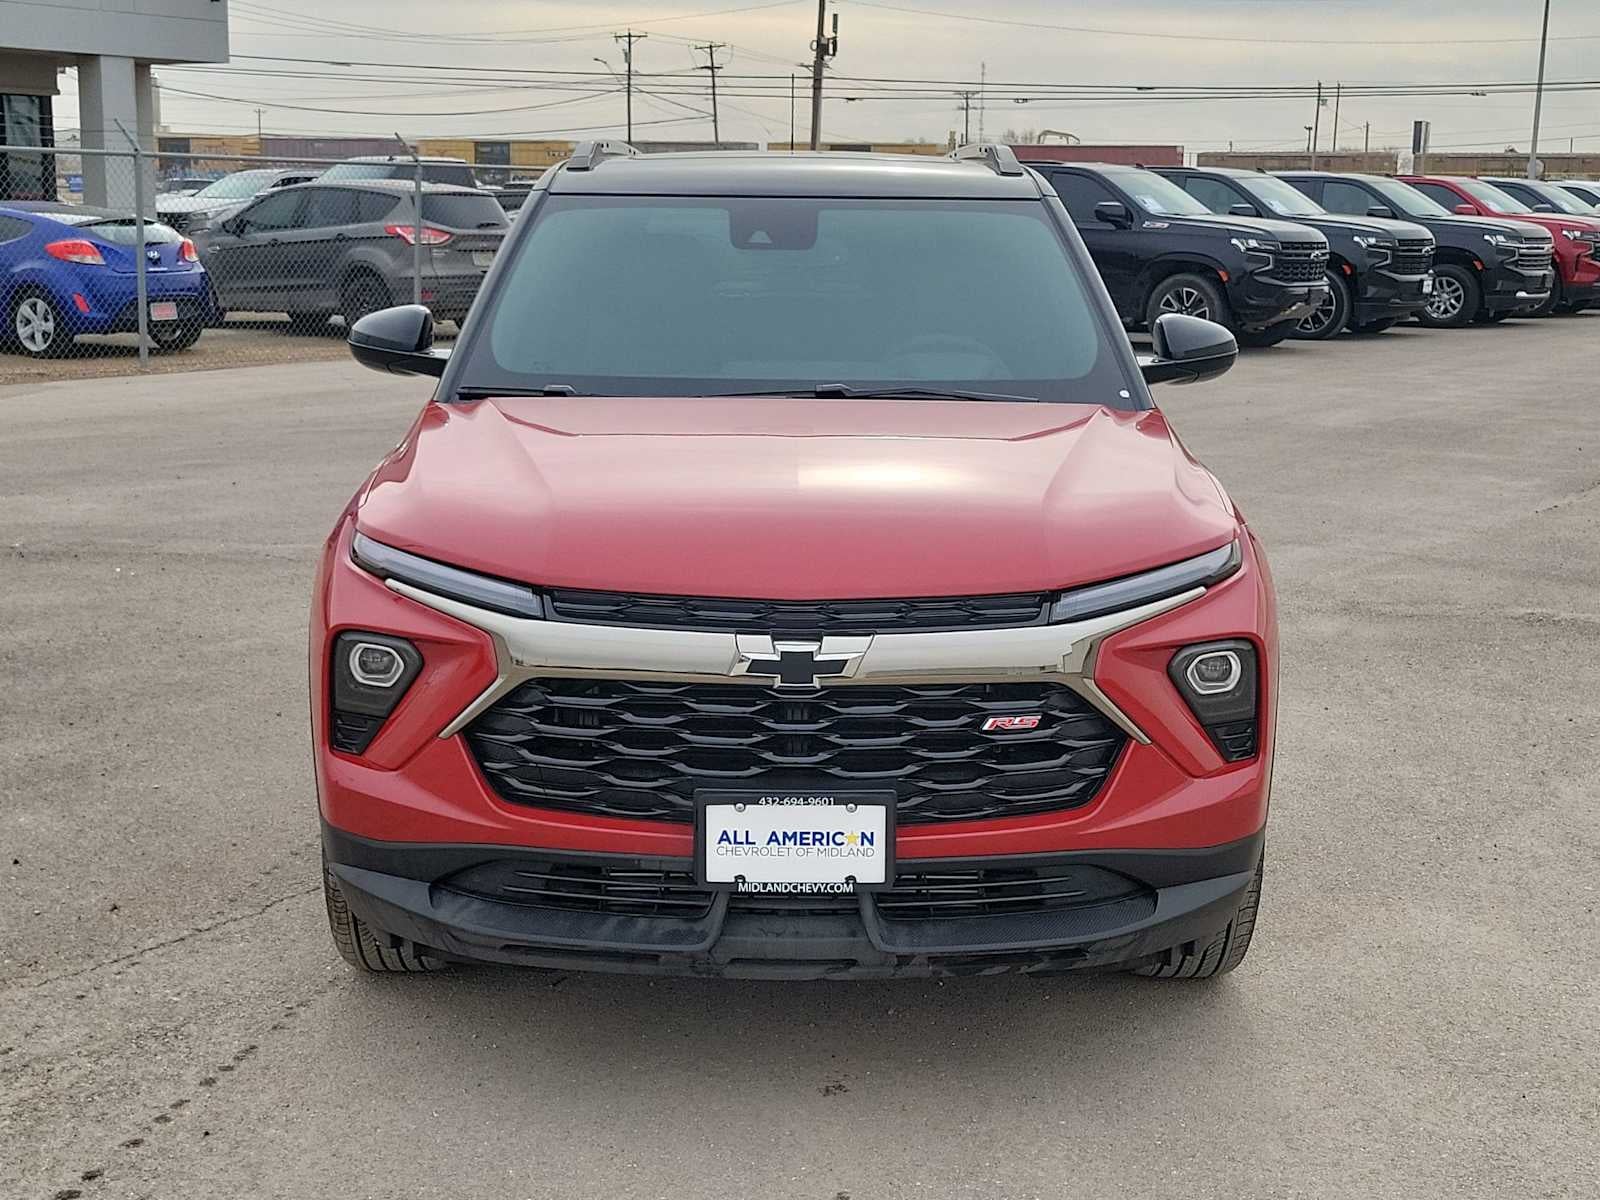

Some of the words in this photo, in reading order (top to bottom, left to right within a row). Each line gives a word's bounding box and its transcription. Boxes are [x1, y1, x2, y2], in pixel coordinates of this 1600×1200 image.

[982, 716, 1041, 730] RS
[759, 797, 834, 806] 432-694-9601
[717, 830, 756, 845] ALL
[716, 846, 790, 857] CHEVROLET
[796, 847, 815, 857] OF
[817, 847, 875, 857] MIDLAND
[738, 882, 854, 893] MIDLANDCHEVY.COM
